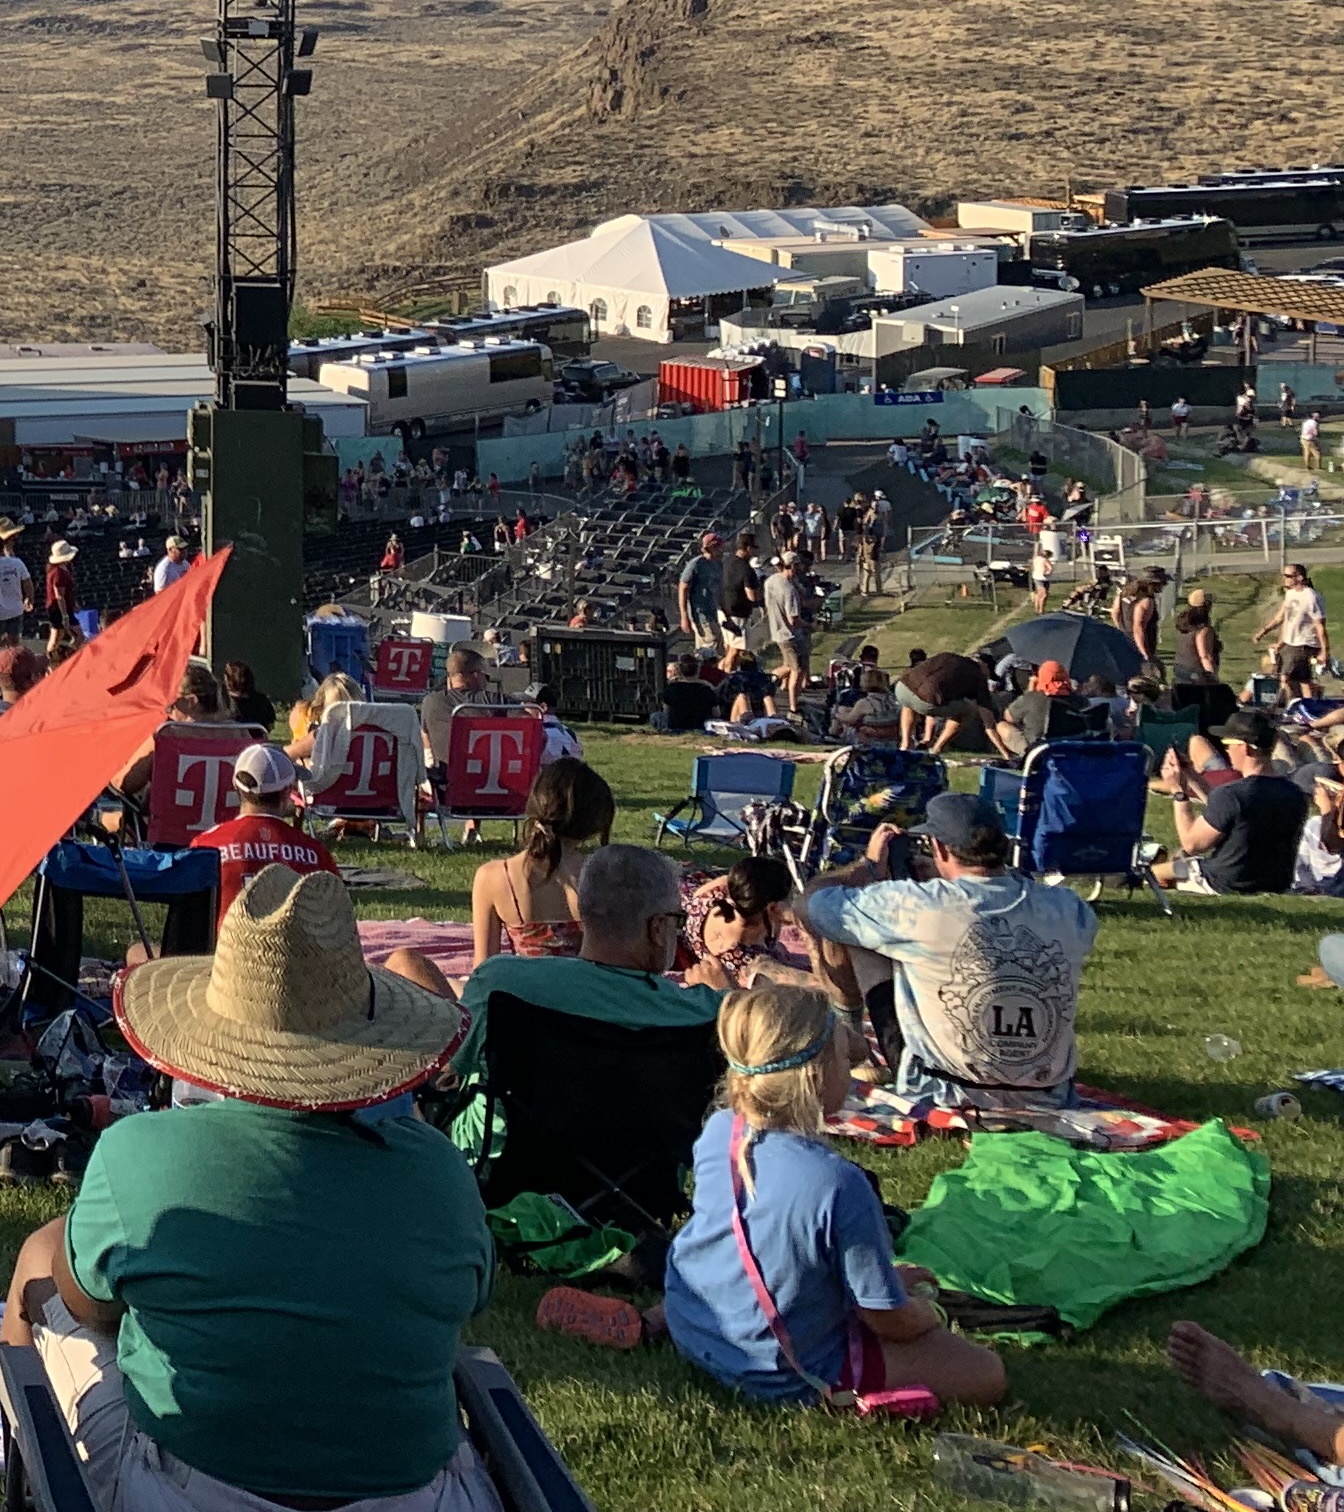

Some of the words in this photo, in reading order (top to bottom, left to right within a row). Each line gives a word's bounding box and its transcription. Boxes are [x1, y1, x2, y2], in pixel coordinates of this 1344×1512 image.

[388, 648, 422, 681] T
[346, 730, 395, 796] T
[467, 730, 524, 794] T
[176, 754, 238, 831] T
[220, 841, 318, 865] BEAUFORD
[992, 1005, 1036, 1038] LA
